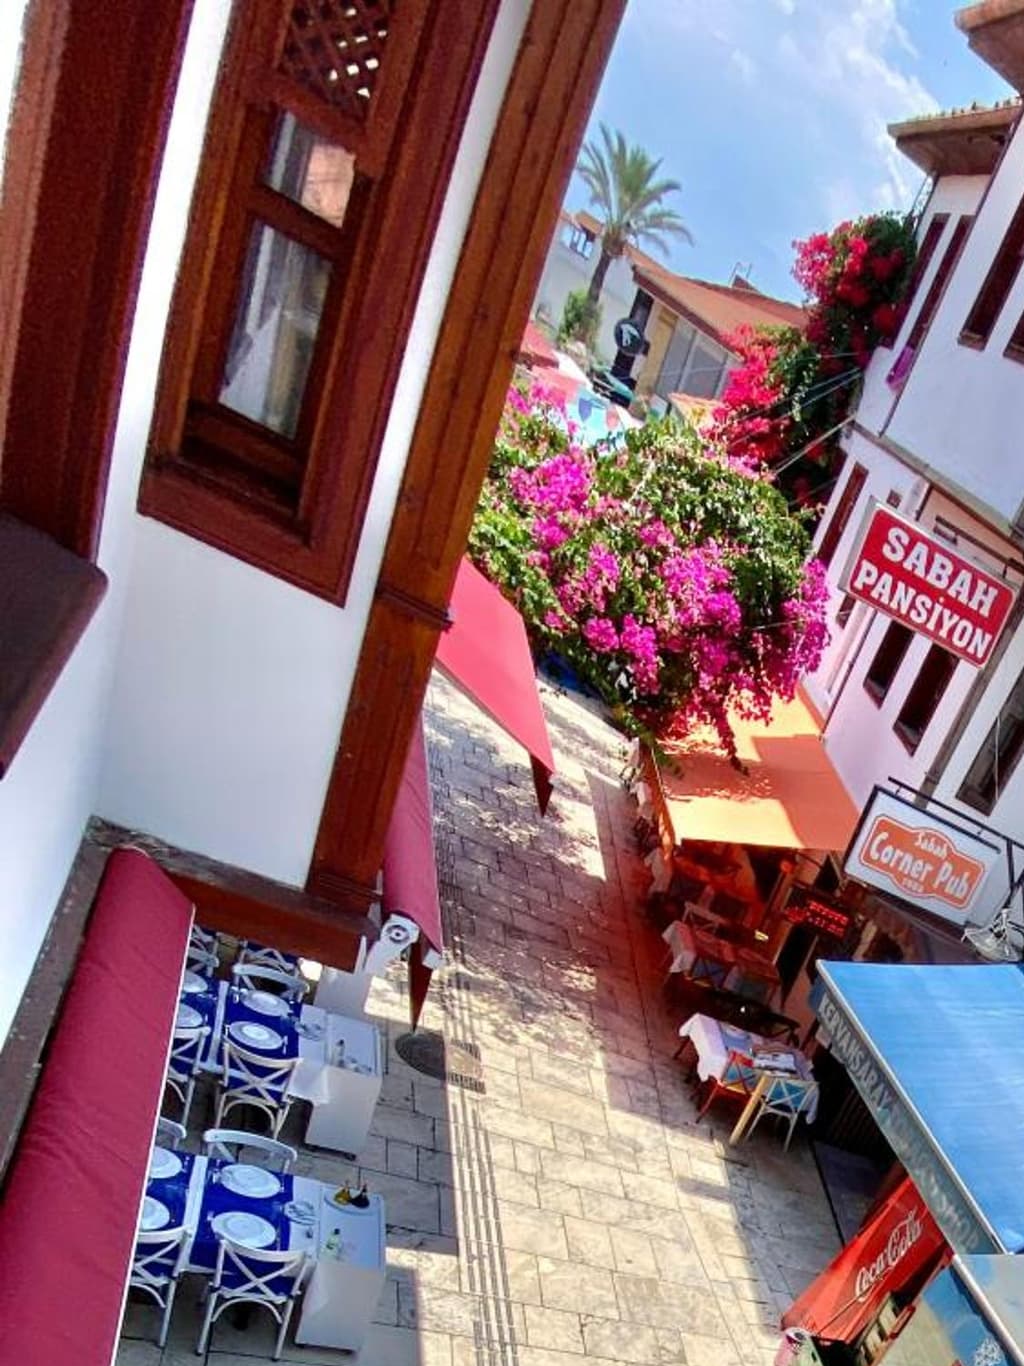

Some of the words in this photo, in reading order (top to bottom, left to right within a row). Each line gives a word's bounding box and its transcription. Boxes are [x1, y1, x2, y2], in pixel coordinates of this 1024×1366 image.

[882, 526, 998, 618] SABAH
[869, 831, 934, 882] Corner
[933, 860, 971, 898] Pub
[914, 832, 949, 859] Sabah
[817, 992, 894, 1112] KERVANSARAY
